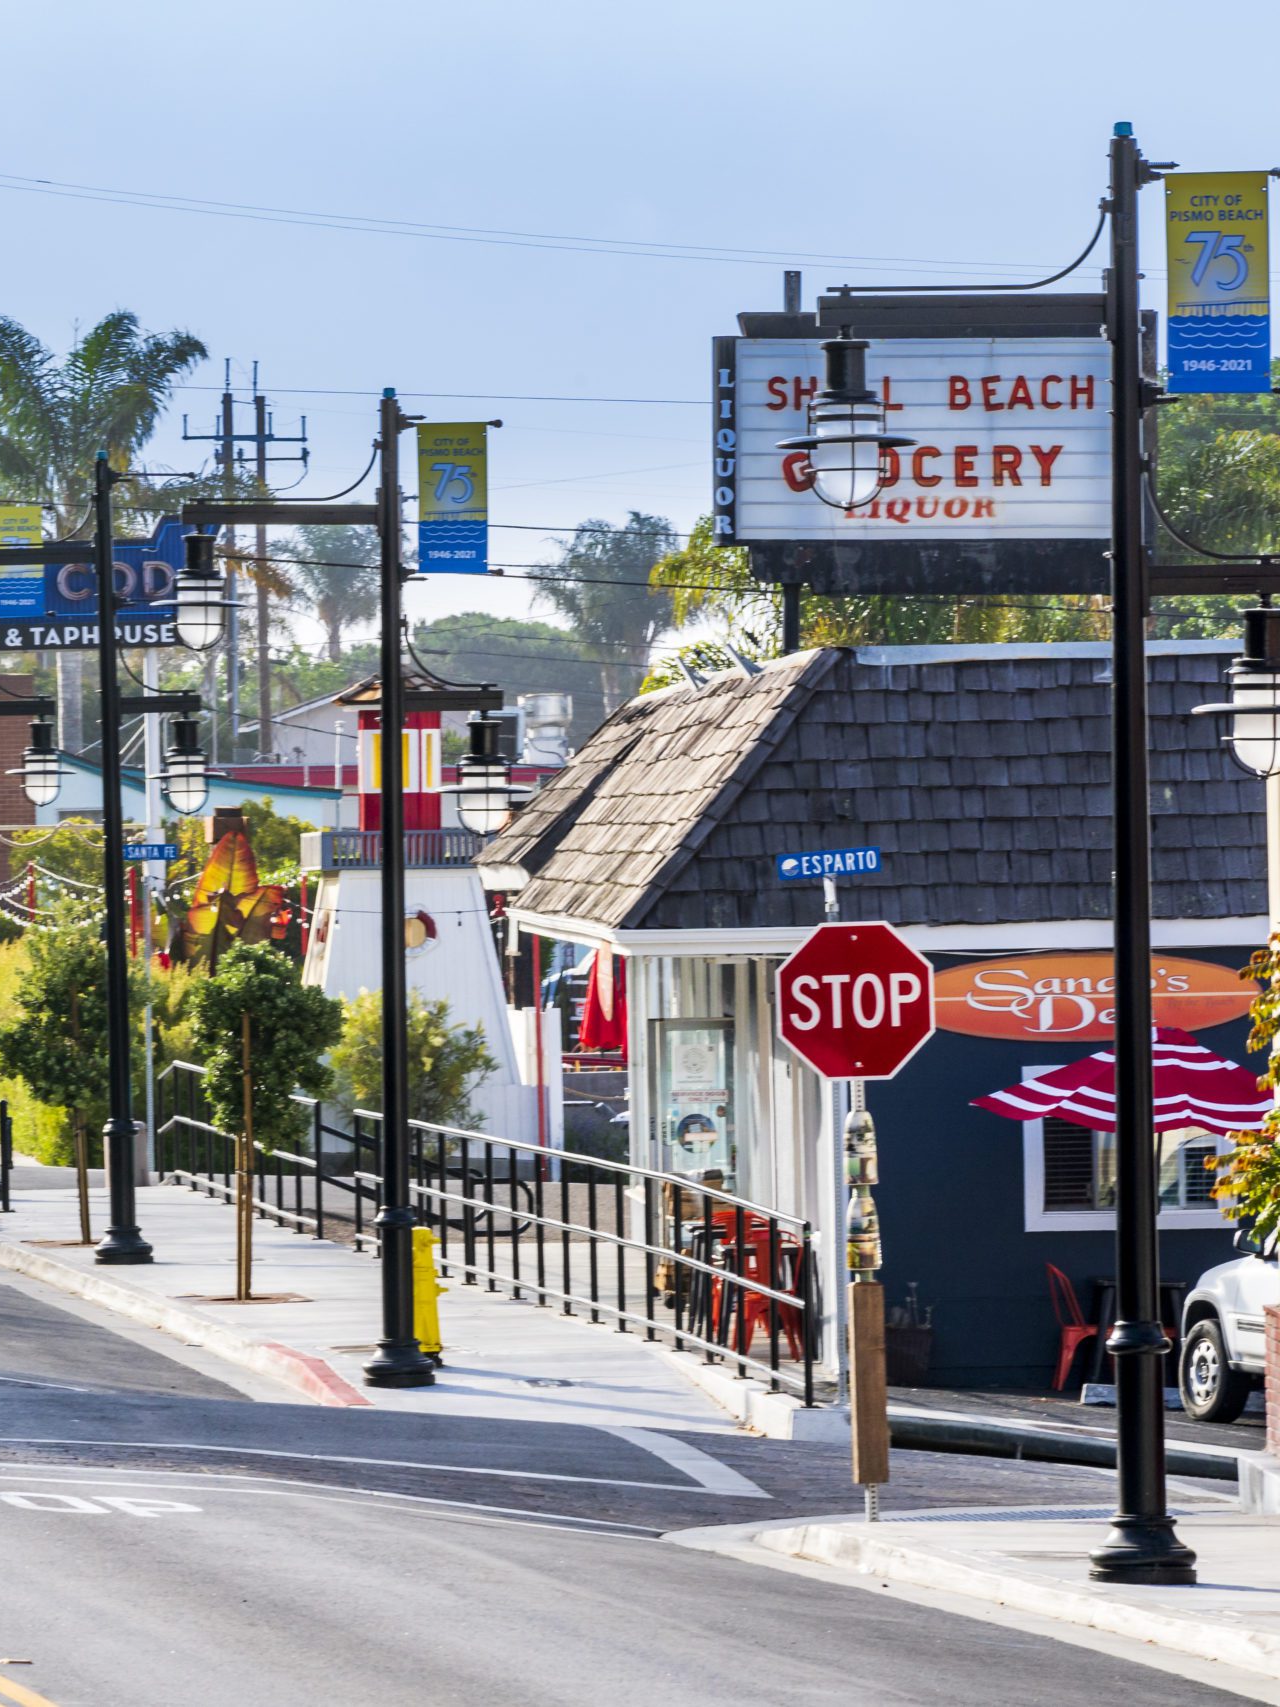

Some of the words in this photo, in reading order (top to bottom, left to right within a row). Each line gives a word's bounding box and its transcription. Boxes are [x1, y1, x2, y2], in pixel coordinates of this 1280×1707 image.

[1189, 195, 1220, 208] CITY
[1223, 194, 1243, 207] OF
[1170, 210, 1214, 222] PISMO
[1217, 209, 1264, 221] BEACH
[1182, 359, 1252, 371] 1946-2021
[765, 375, 904, 411] SHL
[948, 374, 1095, 412] BEACH
[714, 368, 736, 535] LIQUOR
[782, 444, 1064, 493] GOCERY
[843, 496, 997, 524] LIQUOR
[428, 550, 477, 559] 1946-2021
[4, 629, 23, 647] &
[28, 623, 176, 646] TAPHUSE
[127, 846, 160, 858] SANTA
[163, 846, 176, 858] FE
[801, 850, 877, 875] ESPARTO
[789, 972, 922, 1032] STOP
[966, 968, 1190, 1011] San's
